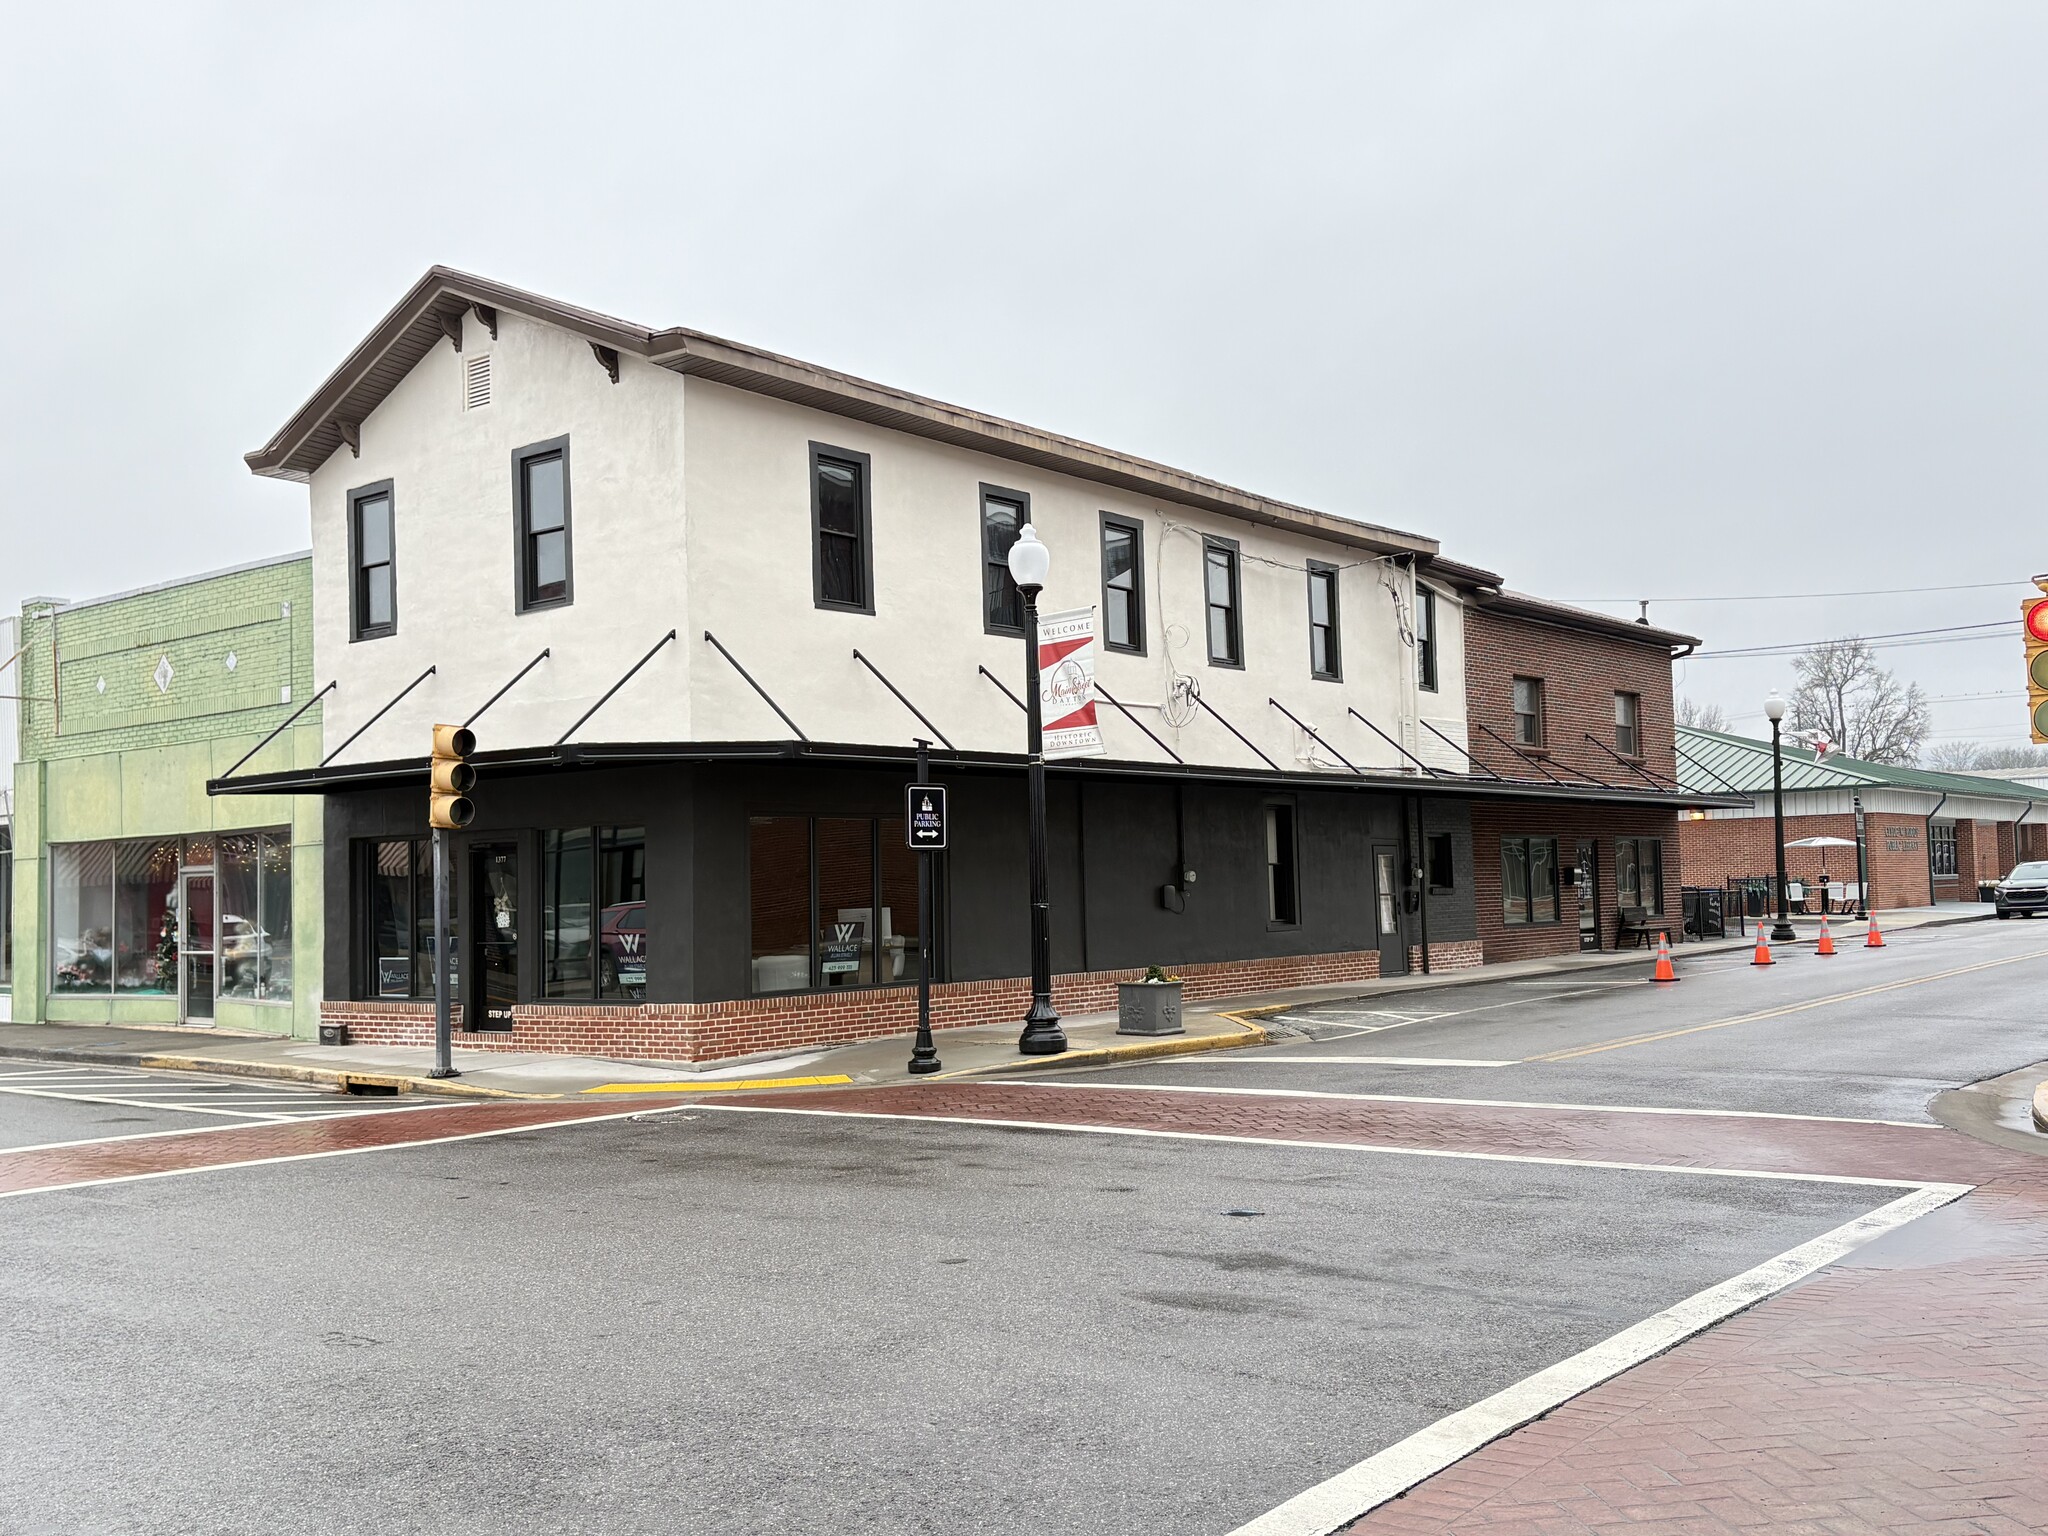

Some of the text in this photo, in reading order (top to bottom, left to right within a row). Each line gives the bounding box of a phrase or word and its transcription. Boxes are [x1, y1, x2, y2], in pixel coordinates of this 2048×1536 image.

[1043, 622, 1090, 636] WELCOME
[1054, 731, 1092, 741] HISTORIC
[1050, 737, 1096, 748] DOWNTOWN
[916, 813, 939, 821] PUBLIC
[913, 820, 942, 828] PARKING
[495, 855, 507, 863] 1377
[827, 944, 858, 953] WALLACE
[618, 955, 647, 964] WALLAC
[488, 1009, 512, 1018] STEP UP
